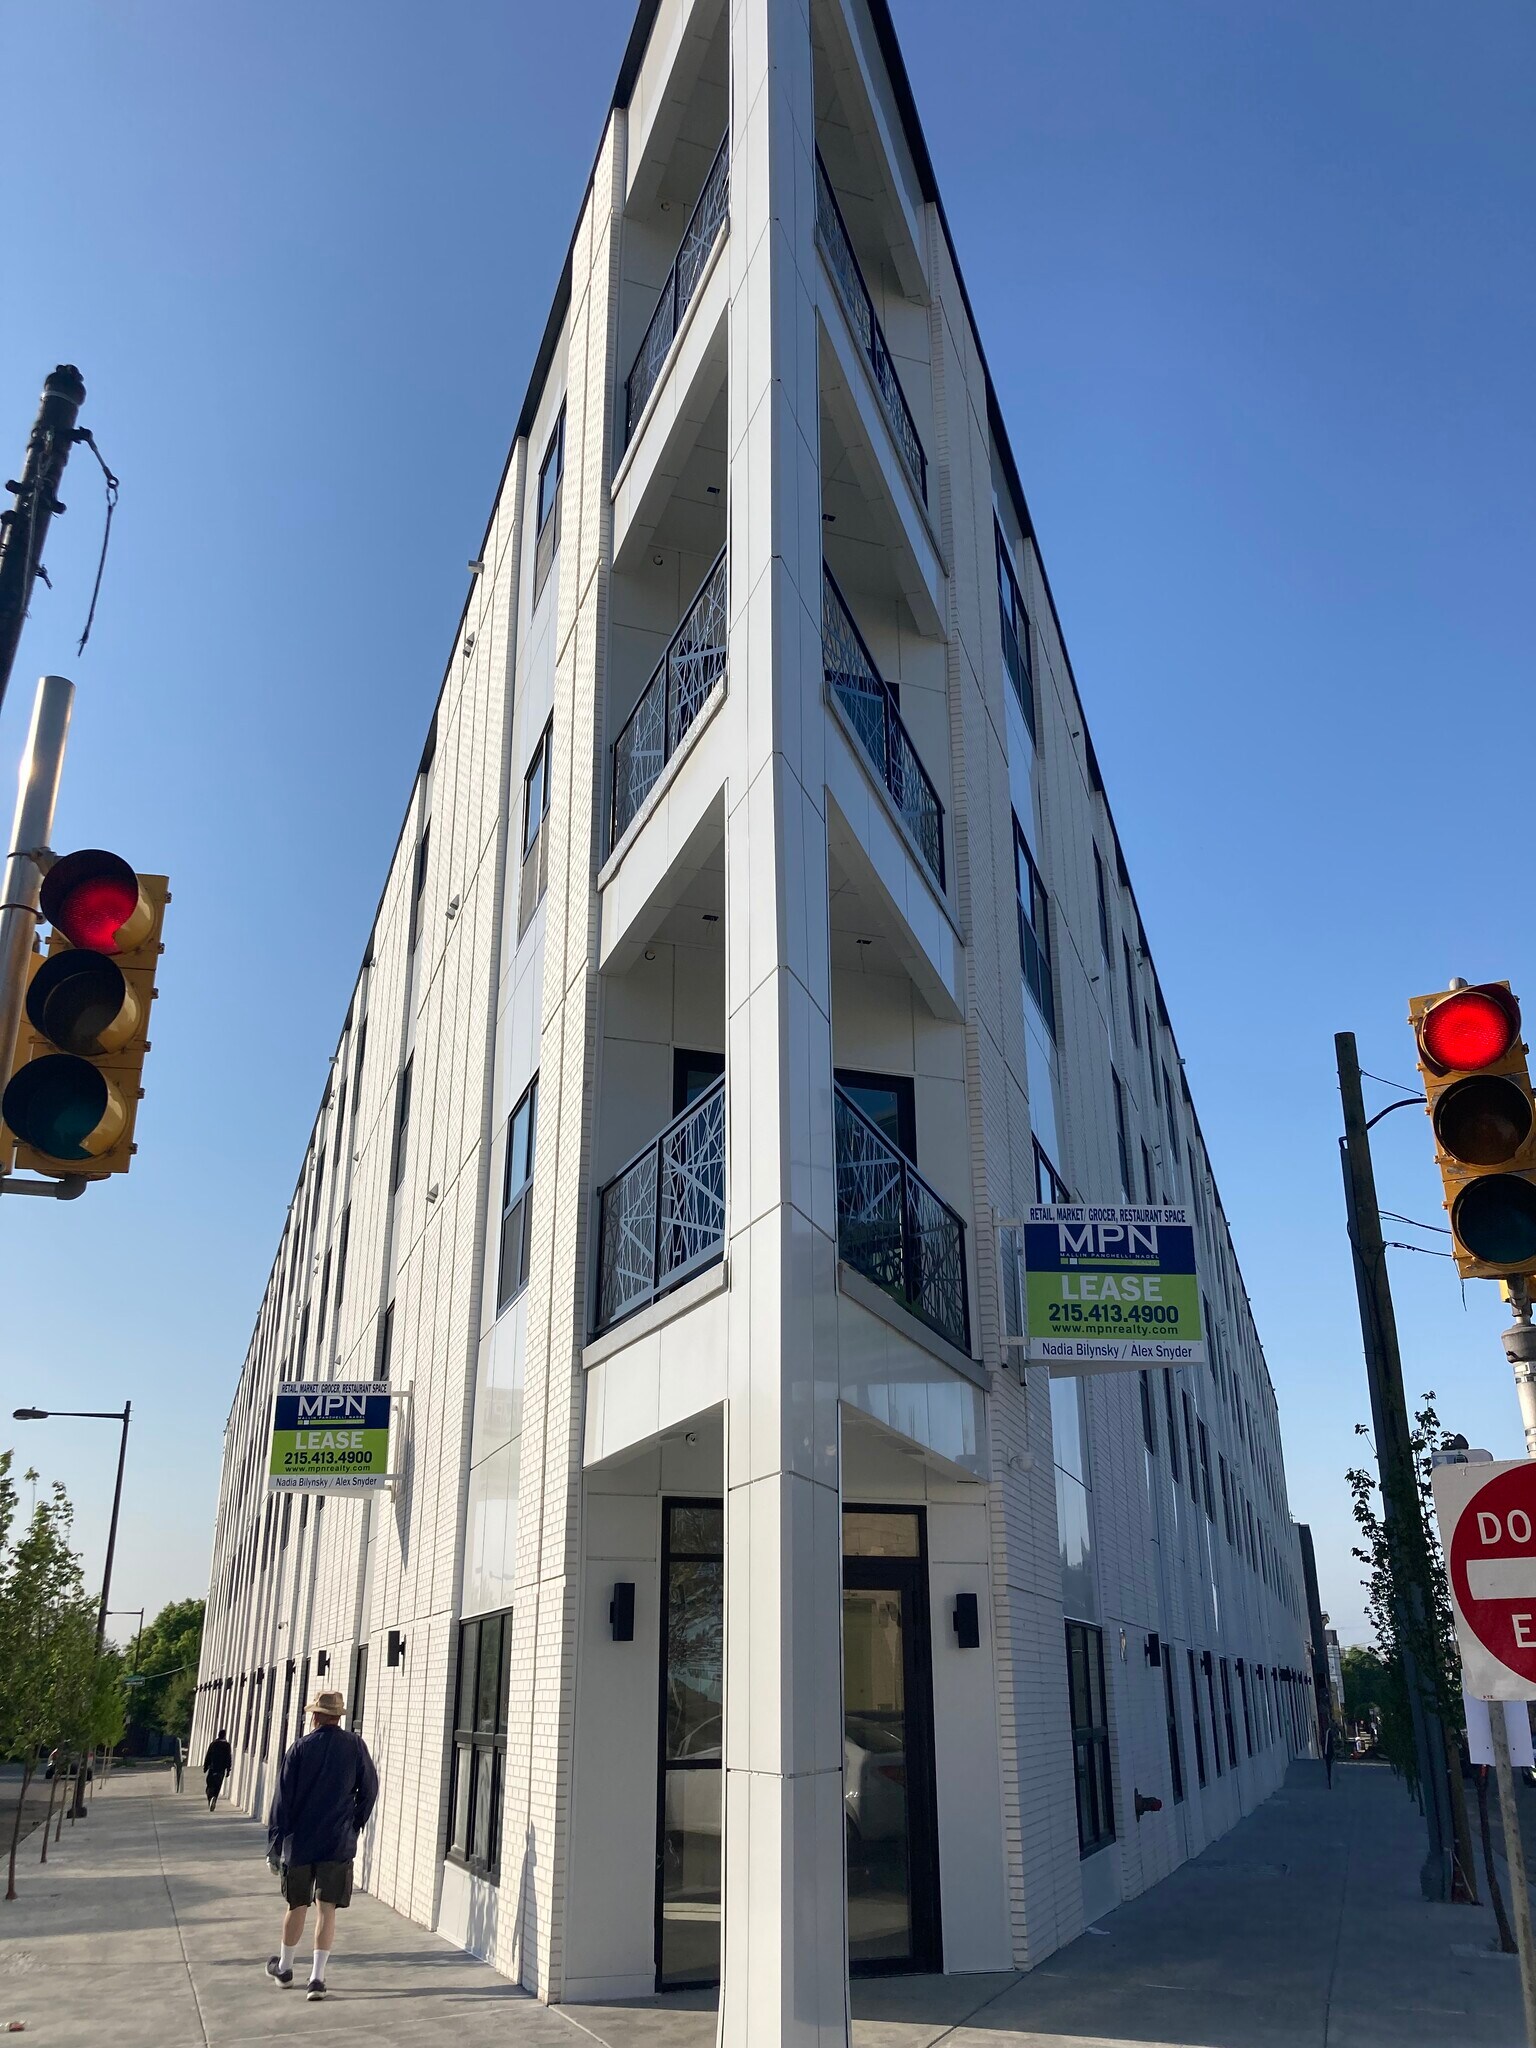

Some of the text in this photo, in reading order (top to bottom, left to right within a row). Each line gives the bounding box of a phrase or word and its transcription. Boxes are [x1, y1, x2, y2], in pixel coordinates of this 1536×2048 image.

[1030, 1208, 1055, 1222] RETAIL,
[1089, 1208, 1118, 1223] GROCER,
[1120, 1209, 1162, 1223] RESTAURANT
[1164, 1210, 1186, 1223] SPACE
[1059, 1224, 1159, 1254] MPN
[1061, 1275, 1162, 1302] LEASE
[1048, 1303, 1179, 1324] 215.413.4900
[1052, 1324, 1178, 1336] www.mpnrealty.com
[1042, 1343, 1073, 1356] Nadia
[1076, 1343, 1119, 1359] Bilynsky
[1131, 1345, 1153, 1357] Alex
[1156, 1345, 1192, 1360] Snyder
[342, 1384, 371, 1394] RESTAURANT
[372, 1384, 387, 1394] SPACE
[298, 1396, 366, 1416] MPN
[295, 1432, 364, 1450] LEASE
[284, 1451, 372, 1464] 215.413.4900
[285, 1465, 370, 1473] www.mpnrealty.com
[276, 1478, 296, 1487] Nadia
[299, 1478, 327, 1488] Bilynsky
[335, 1477, 351, 1486] Alex
[352, 1477, 377, 1487] Snyder
[1477, 1509, 1532, 1544] DO
